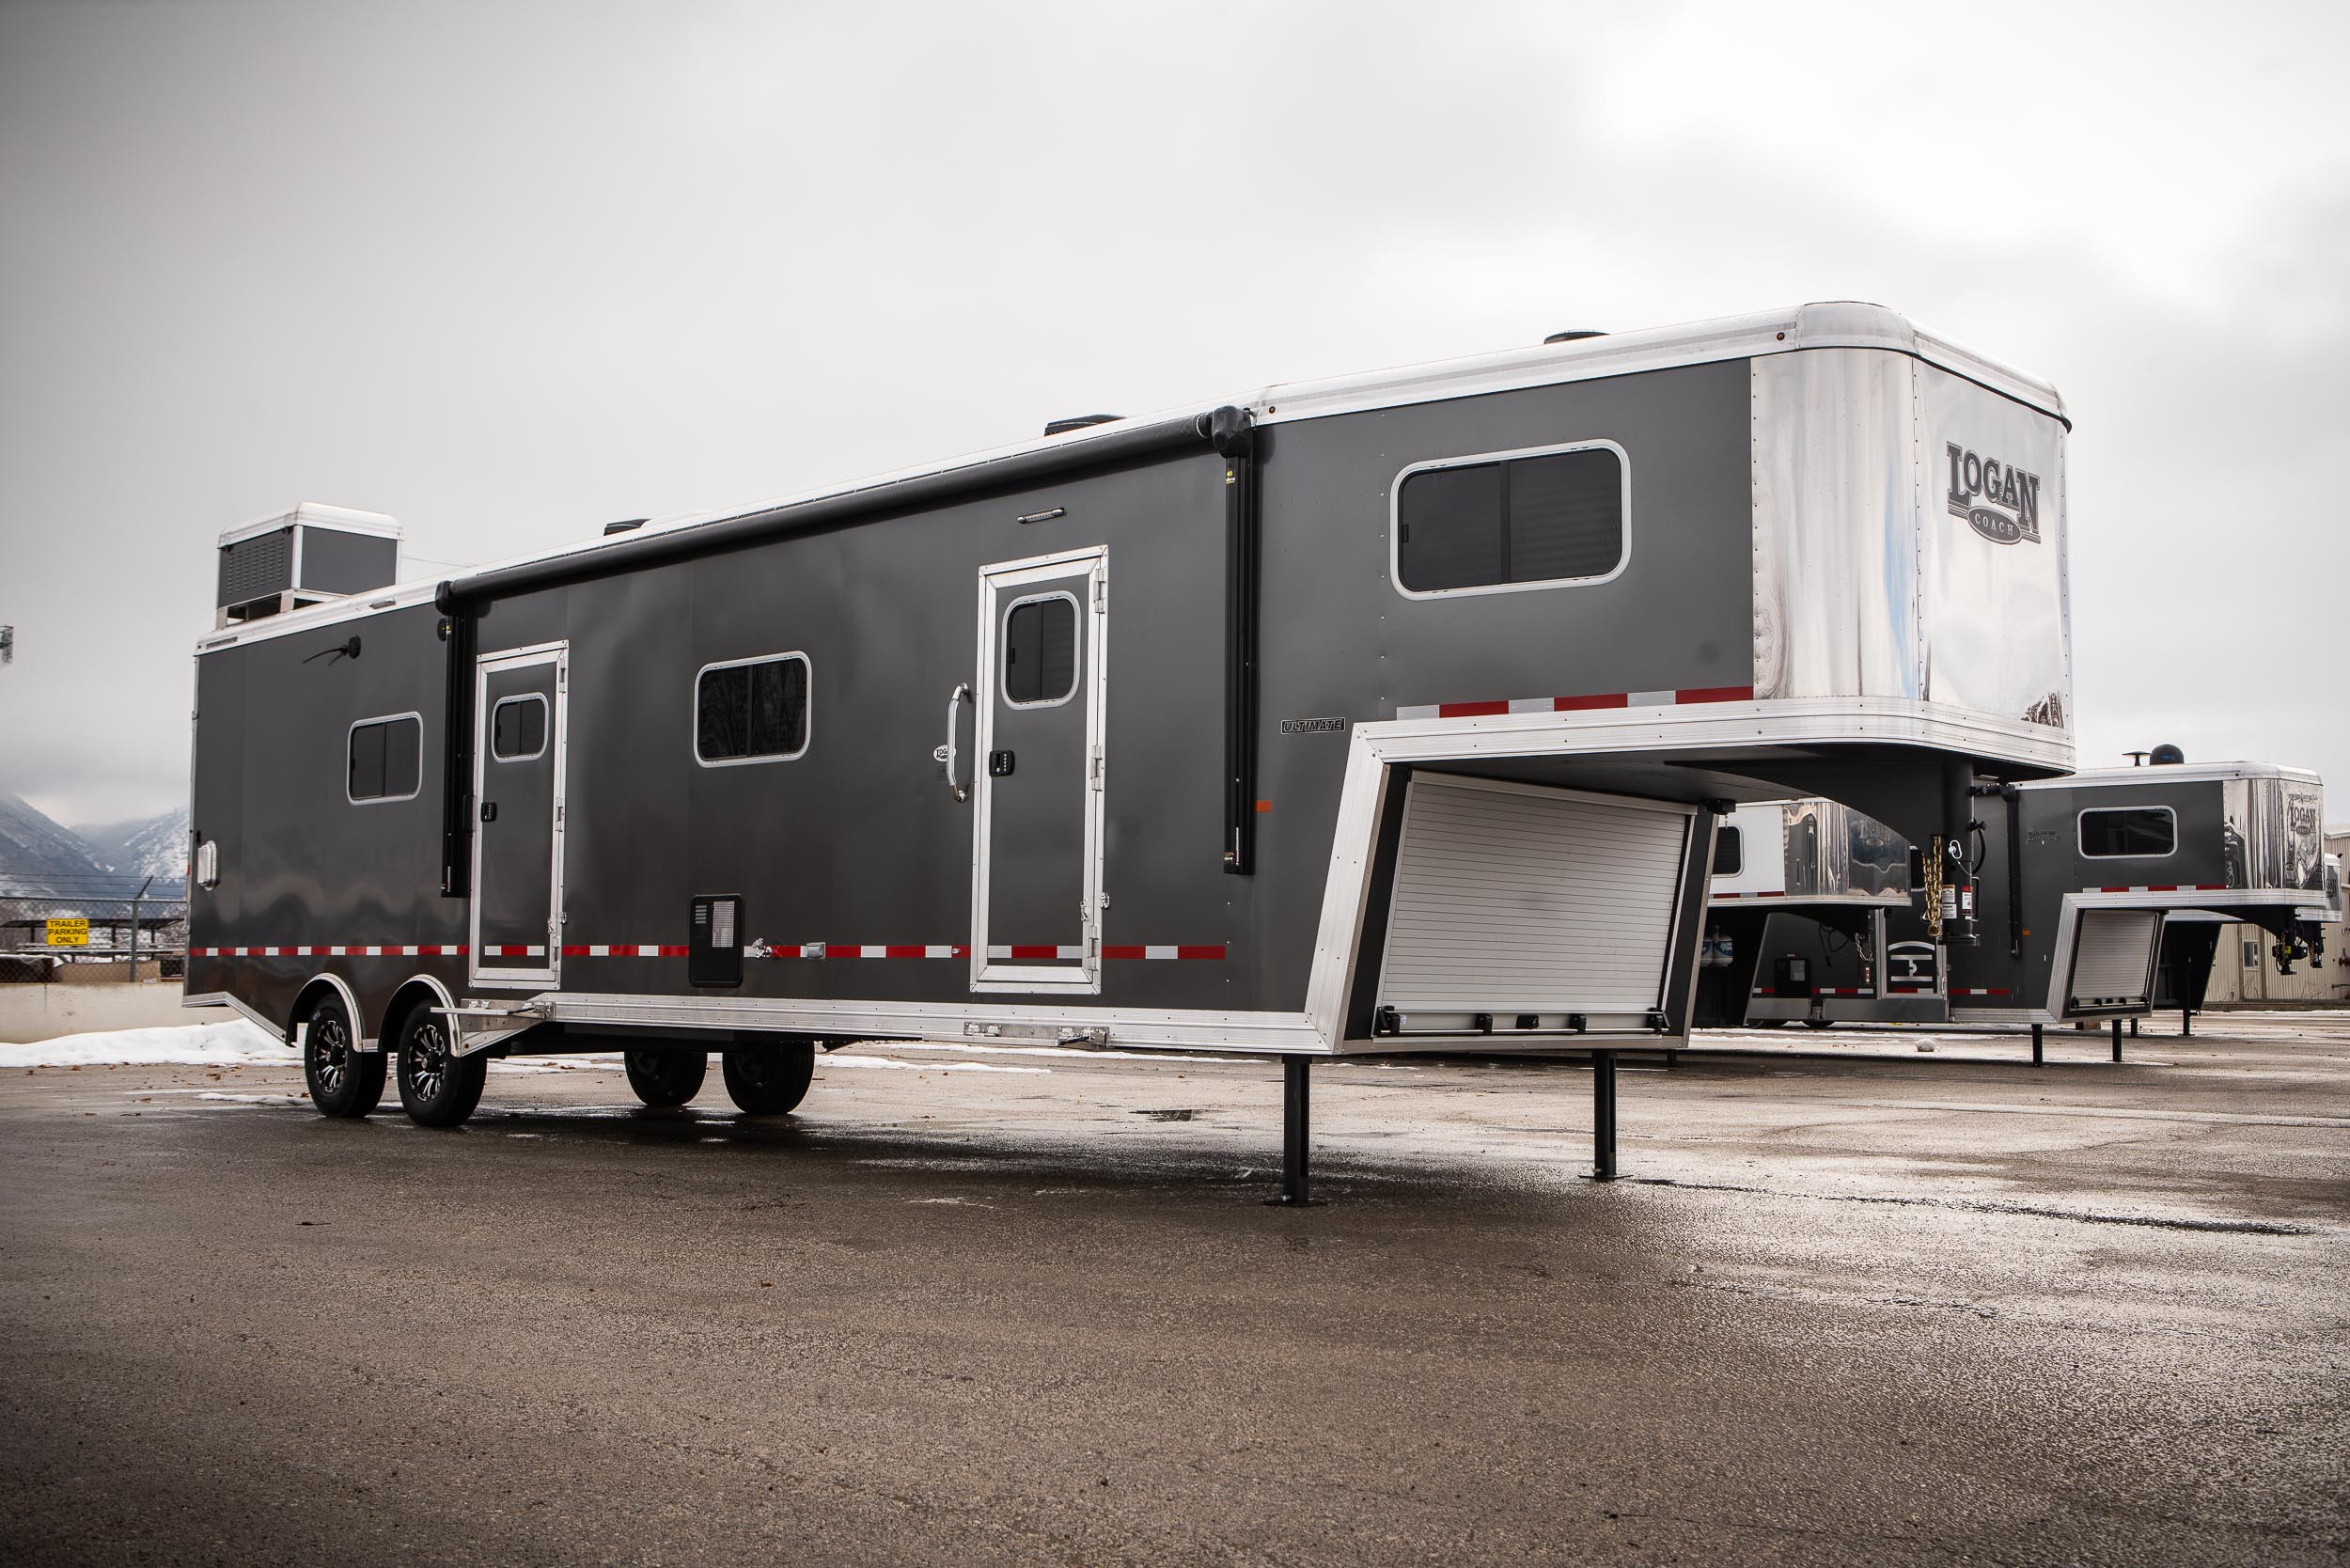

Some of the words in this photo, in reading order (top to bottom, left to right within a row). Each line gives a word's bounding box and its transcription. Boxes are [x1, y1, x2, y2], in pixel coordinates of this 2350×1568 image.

[1947, 441, 2040, 535] LOGAN
[1975, 513, 2013, 536] COACH
[1283, 718, 1343, 732] ULTIMATE
[2289, 807, 2316, 831] LOGAN
